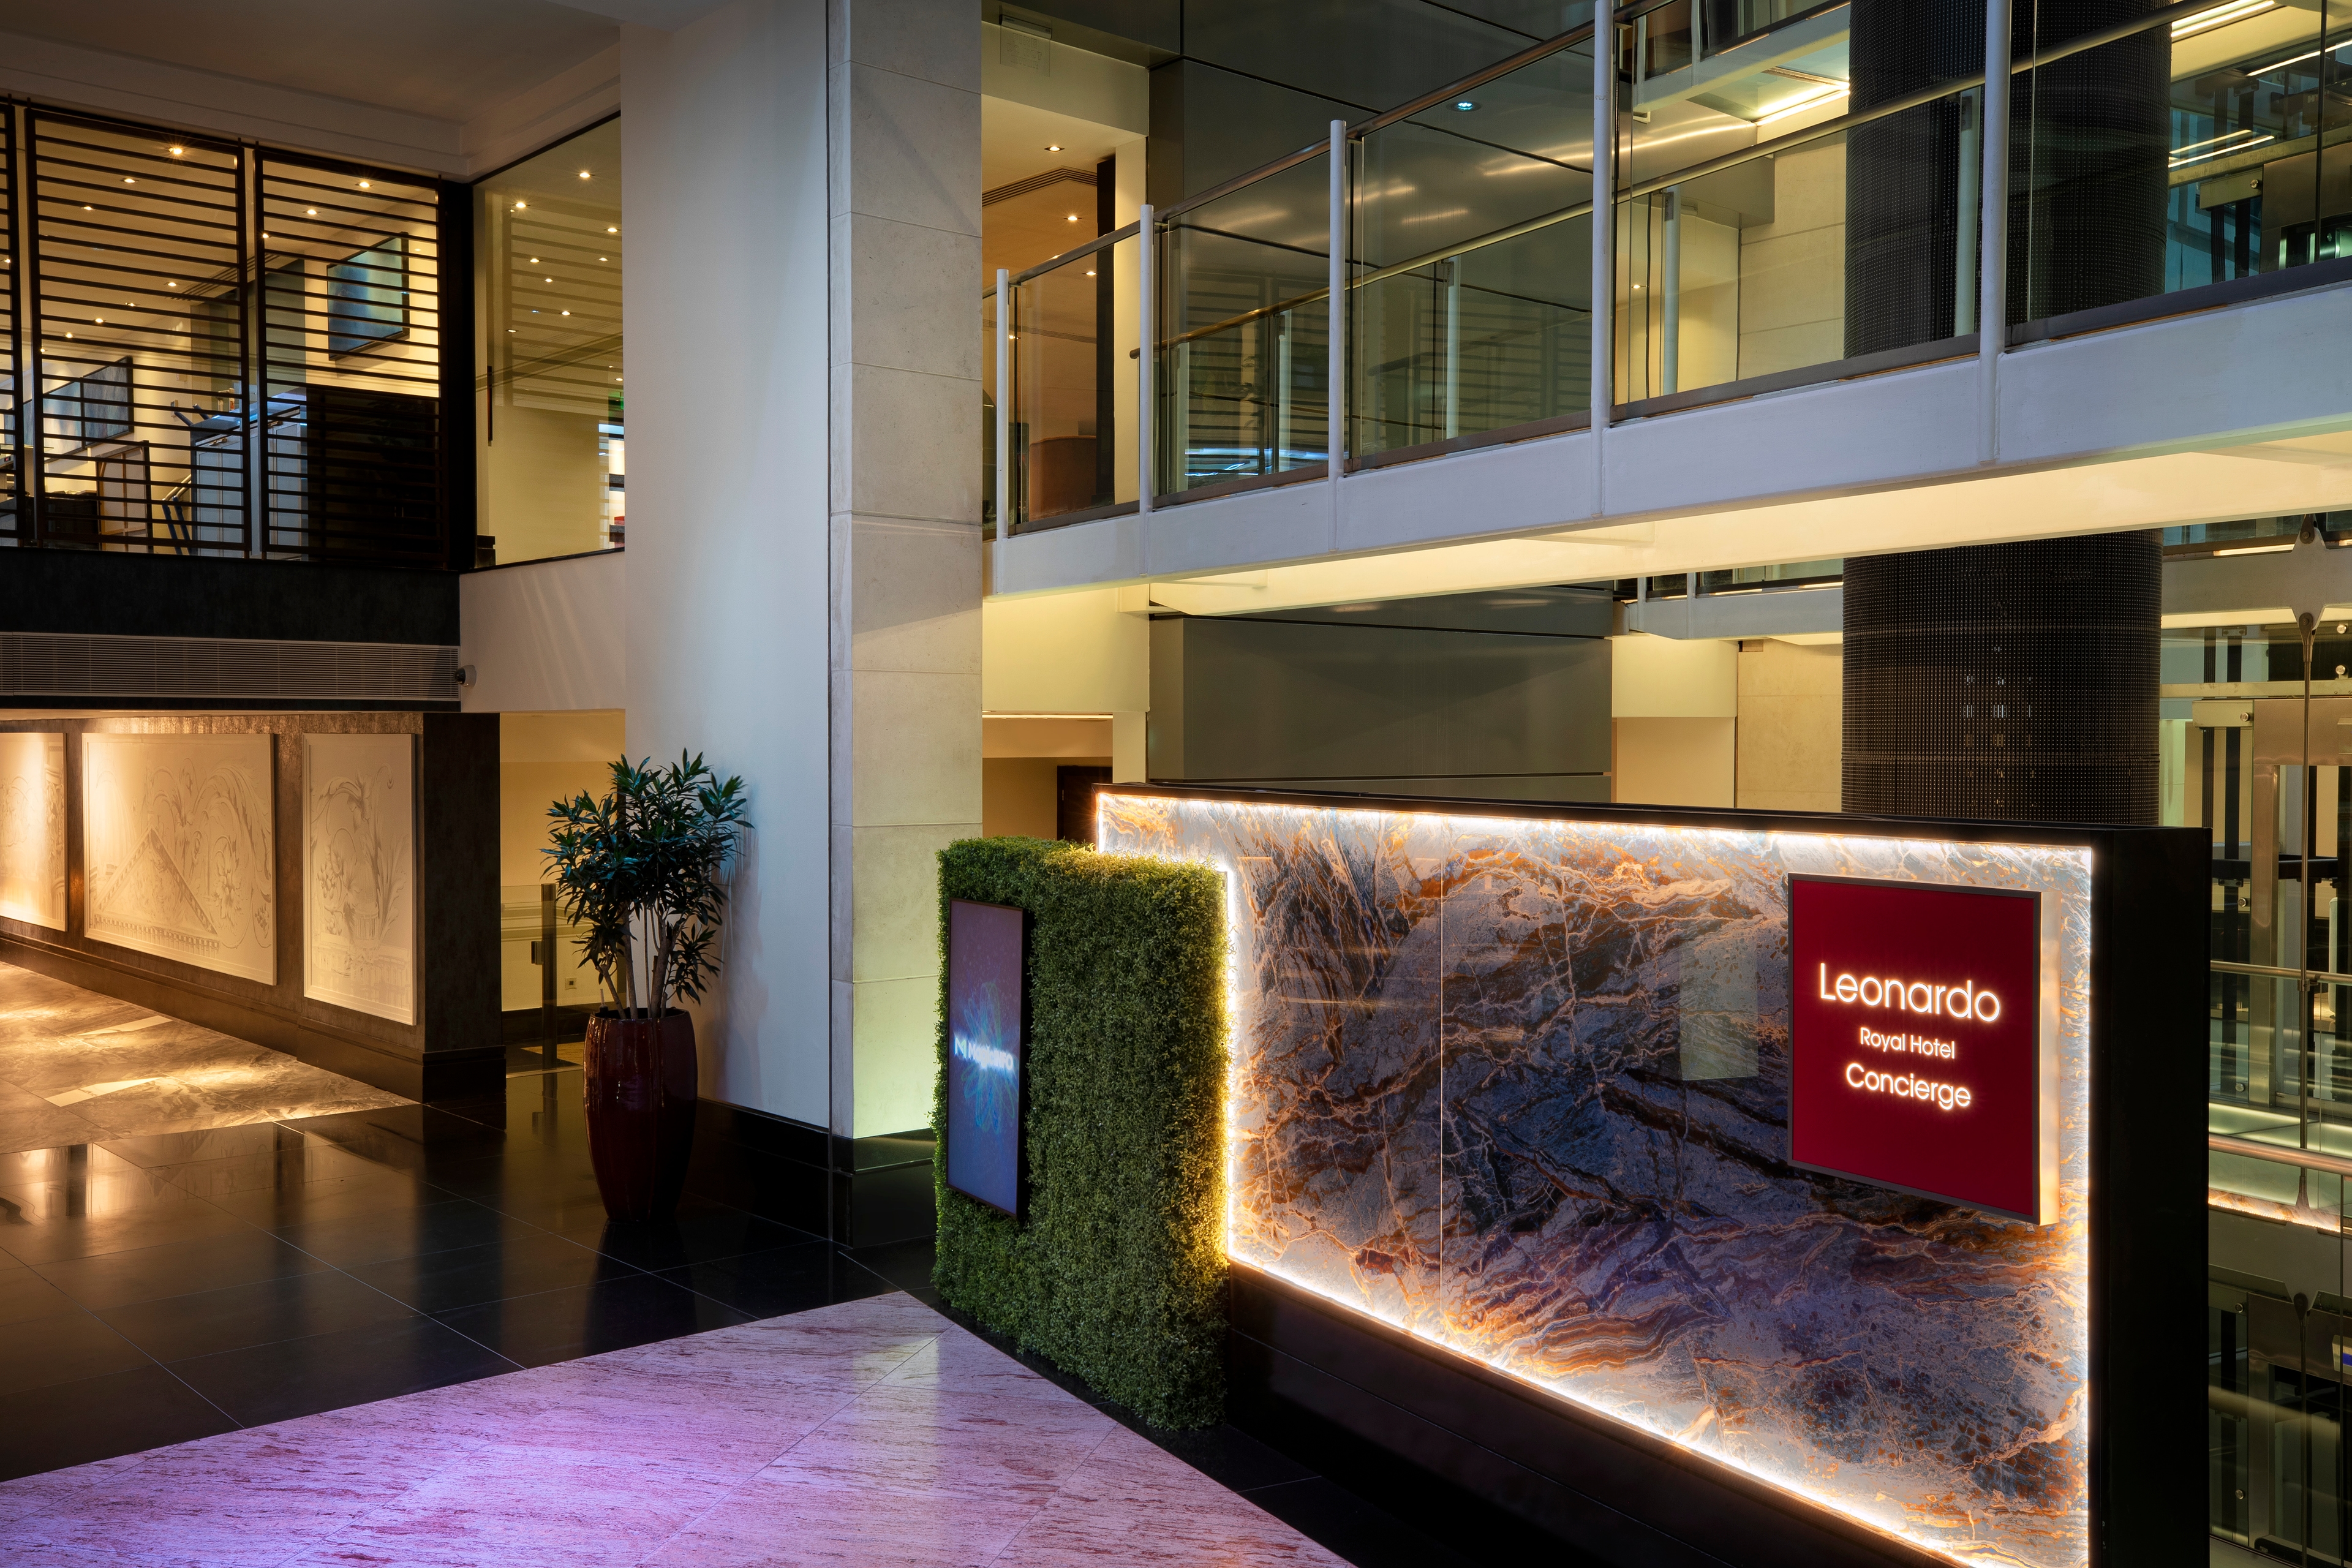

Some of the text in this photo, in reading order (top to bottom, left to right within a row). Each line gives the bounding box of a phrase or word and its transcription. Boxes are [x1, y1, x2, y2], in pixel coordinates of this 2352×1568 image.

[1820, 963, 2000, 1022] Leonardo
[1861, 1027, 1954, 1058] Royal Hotel
[1846, 1063, 1971, 1110] Concierge
